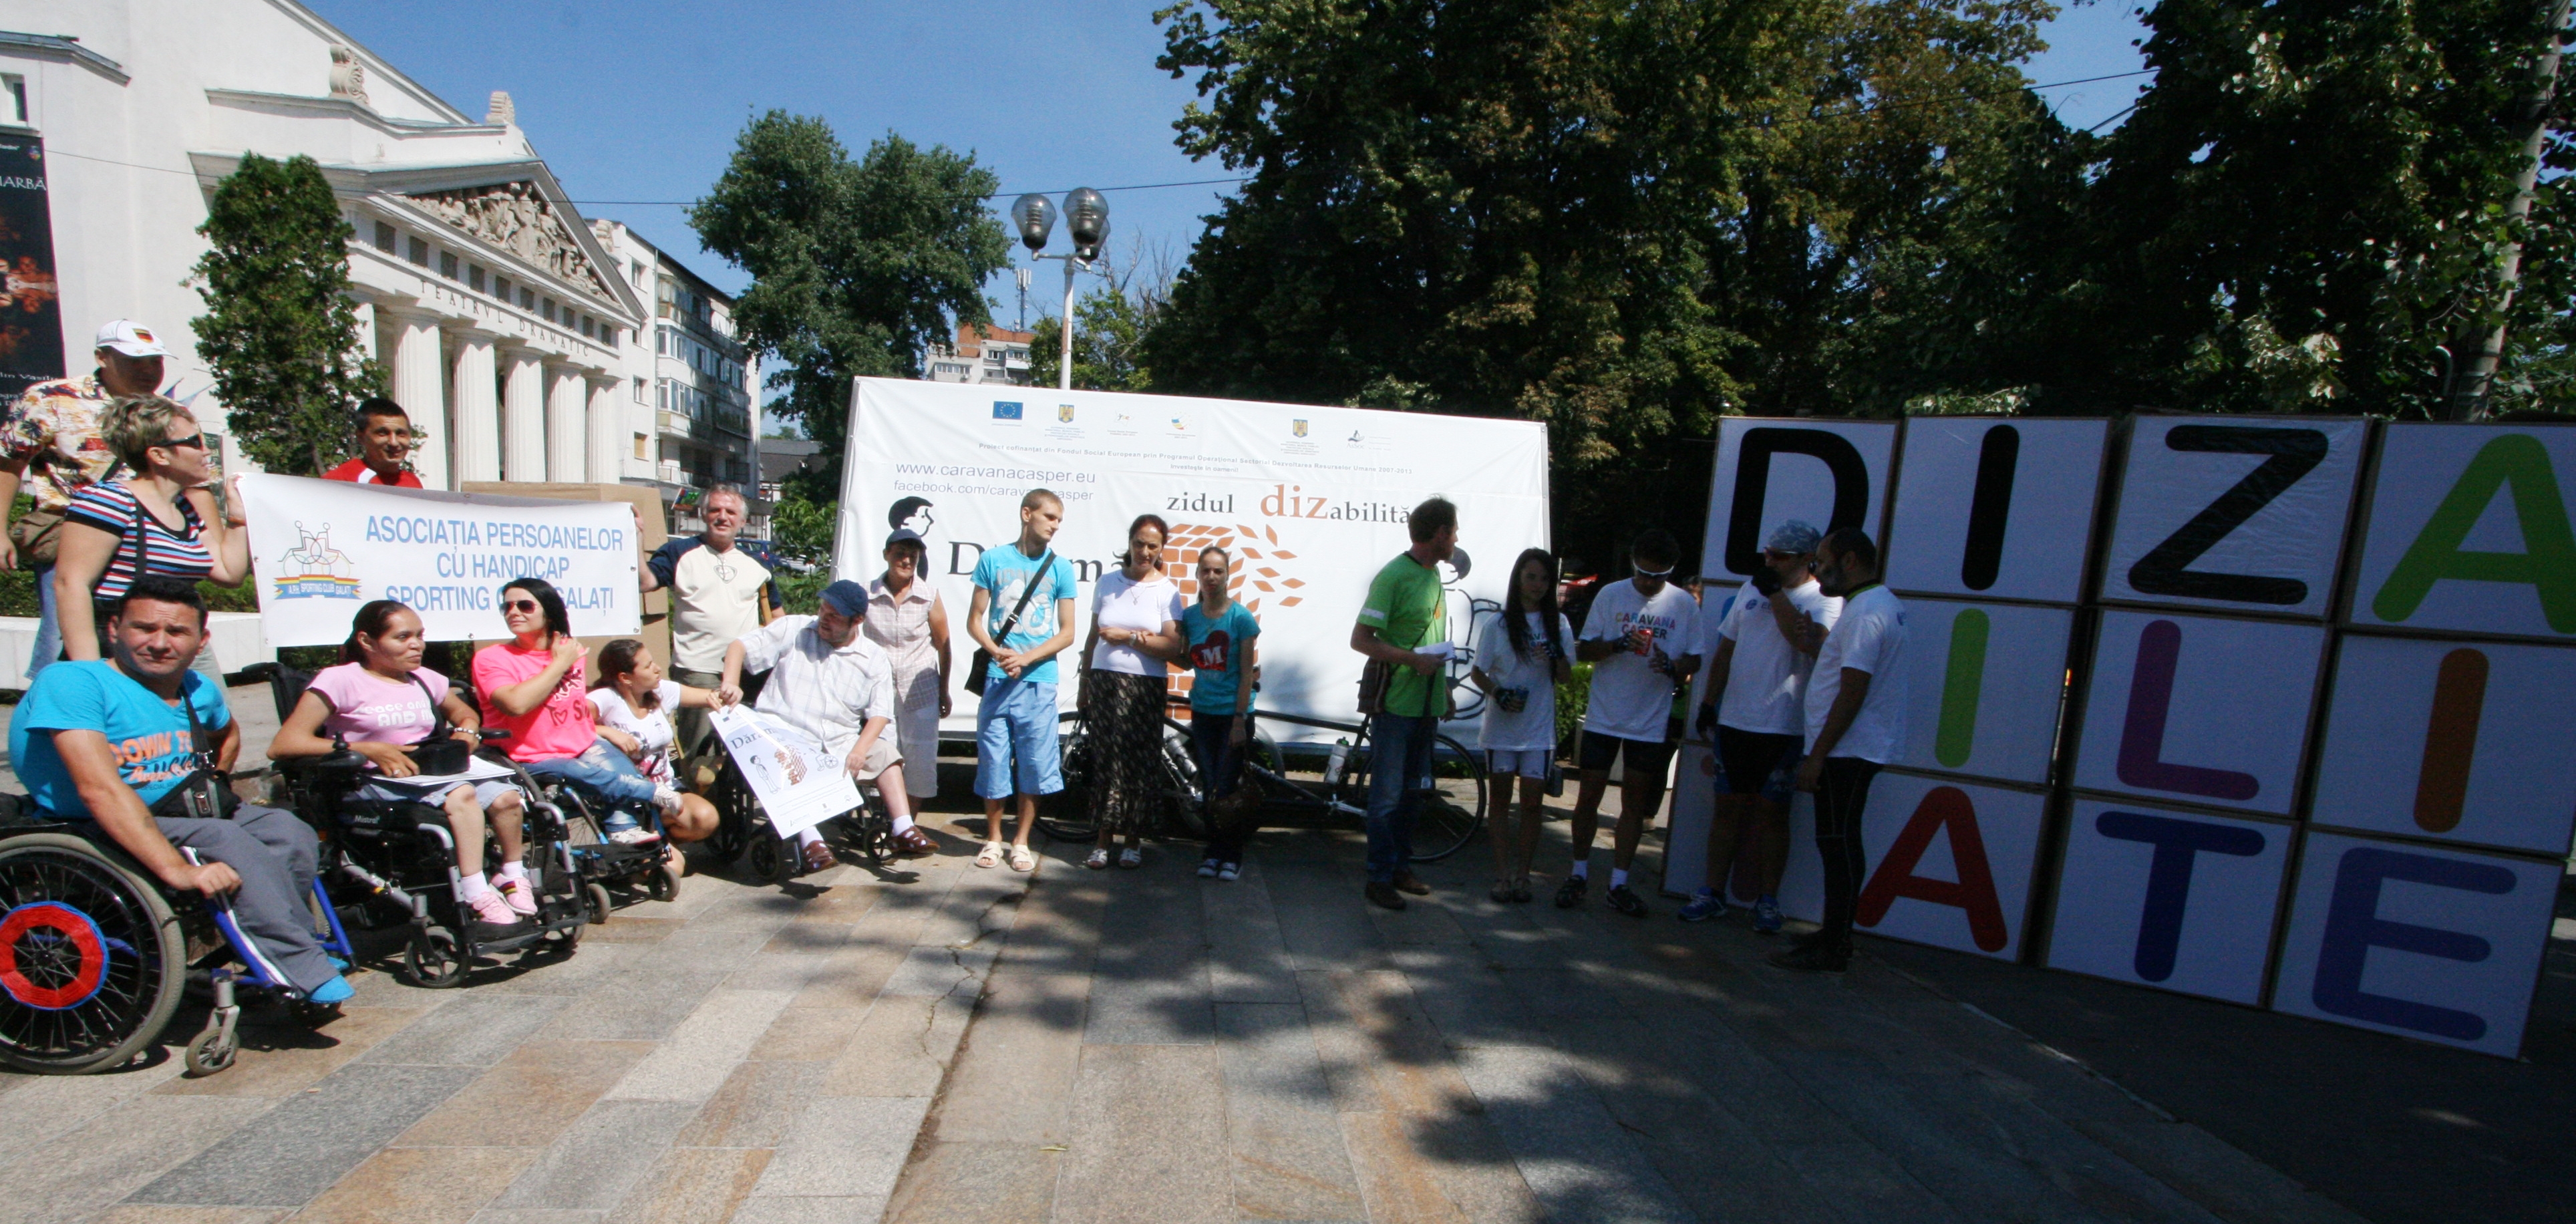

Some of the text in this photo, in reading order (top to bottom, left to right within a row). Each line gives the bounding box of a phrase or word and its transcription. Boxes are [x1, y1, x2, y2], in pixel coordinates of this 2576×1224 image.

[421, 280, 589, 357] TEATRVL DRAMATIC
[896, 464, 1096, 483] www.caravanacasper.eu
[1159, 453, 1196, 461] Programul
[1239, 458, 1271, 466] Sectorial
[1272, 460, 1312, 468] Dezvoltarea
[1314, 462, 1351, 470] Resurselor
[1378, 466, 1412, 474] 2007-2013
[894, 480, 1094, 502] facebook.com/caravasper
[1166, 492, 1235, 514] zidul
[486, 522, 623, 551] PERSOANELOR
[437, 553, 570, 580] CU HANDICAP
[385, 585, 490, 611] SPORTING
[1615, 612, 1675, 629] CARAVANA
[1201, 645, 1224, 666] M
